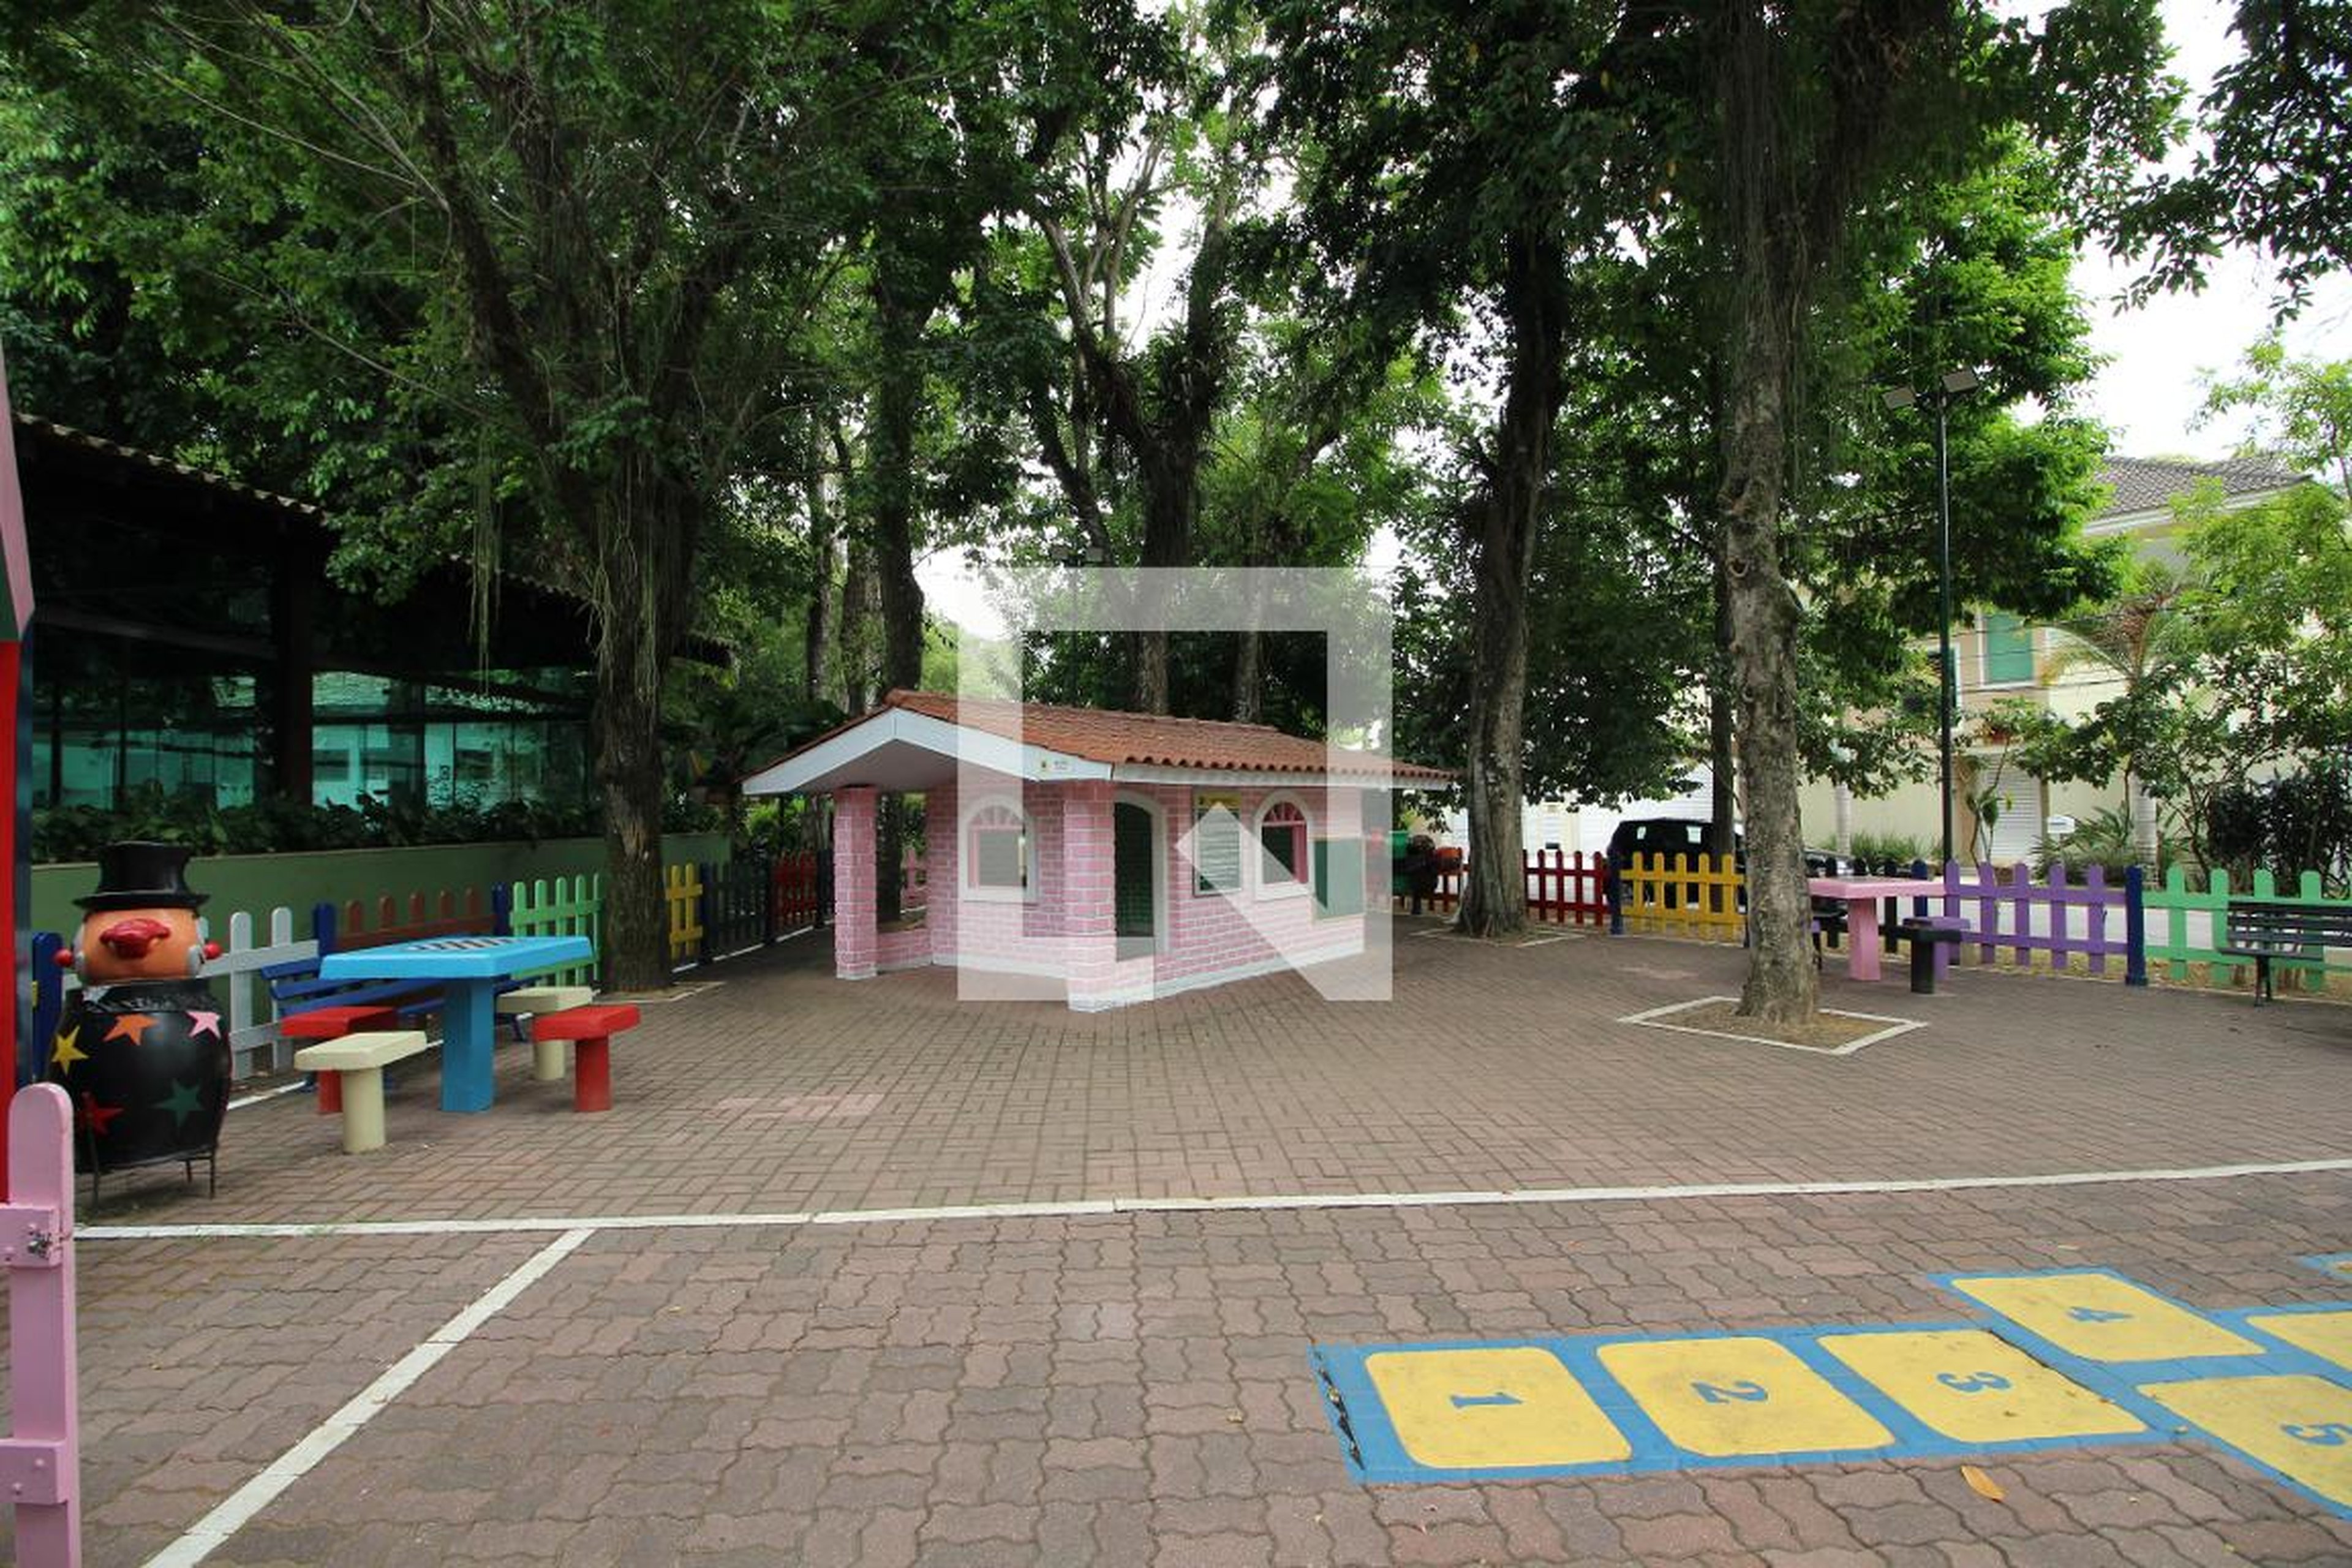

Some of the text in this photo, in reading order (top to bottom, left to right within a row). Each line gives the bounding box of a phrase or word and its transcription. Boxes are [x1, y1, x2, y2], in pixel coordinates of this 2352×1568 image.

[1691, 1381, 1768, 1404] 2
[1936, 1371, 2011, 1393] 3
[1450, 1392, 1523, 1408] 1
[2281, 1423, 2352, 1446] 5
